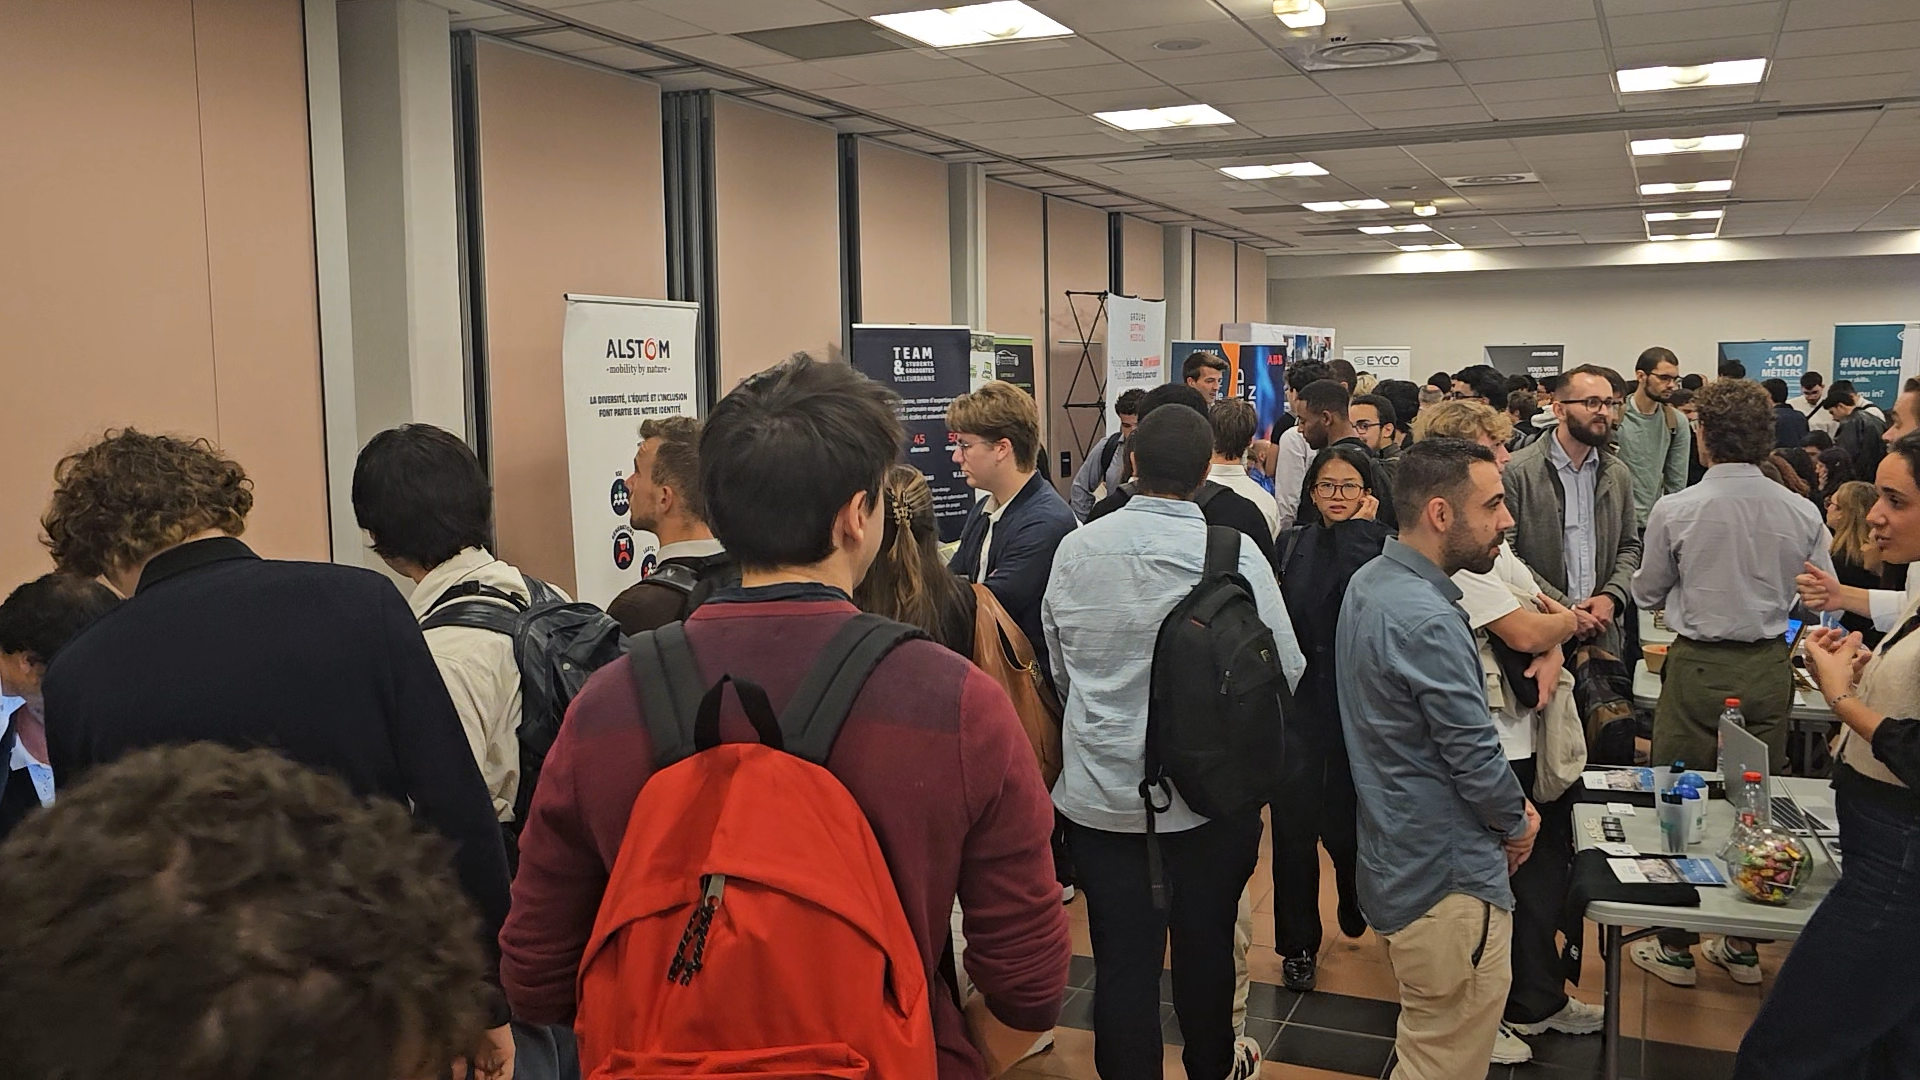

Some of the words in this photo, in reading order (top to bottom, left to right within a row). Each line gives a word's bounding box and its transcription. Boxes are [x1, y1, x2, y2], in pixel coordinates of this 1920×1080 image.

[606, 338, 670, 360] ALSTOM
[892, 346, 932, 360] TEAM
[1267, 354, 1283, 366] ABB
[1764, 354, 1803, 367] +100
[638, 364, 645, 375] by
[646, 365, 667, 374] nature
[894, 360, 905, 376] &
[1761, 367, 1802, 378] MÉTIERS
[590, 396, 597, 404] LA
[650, 394, 656, 402] ET
[599, 408, 613, 417] FONT
[614, 407, 632, 416] PARTIE
[634, 407, 640, 415] DE
[913, 434, 926, 444] 45
